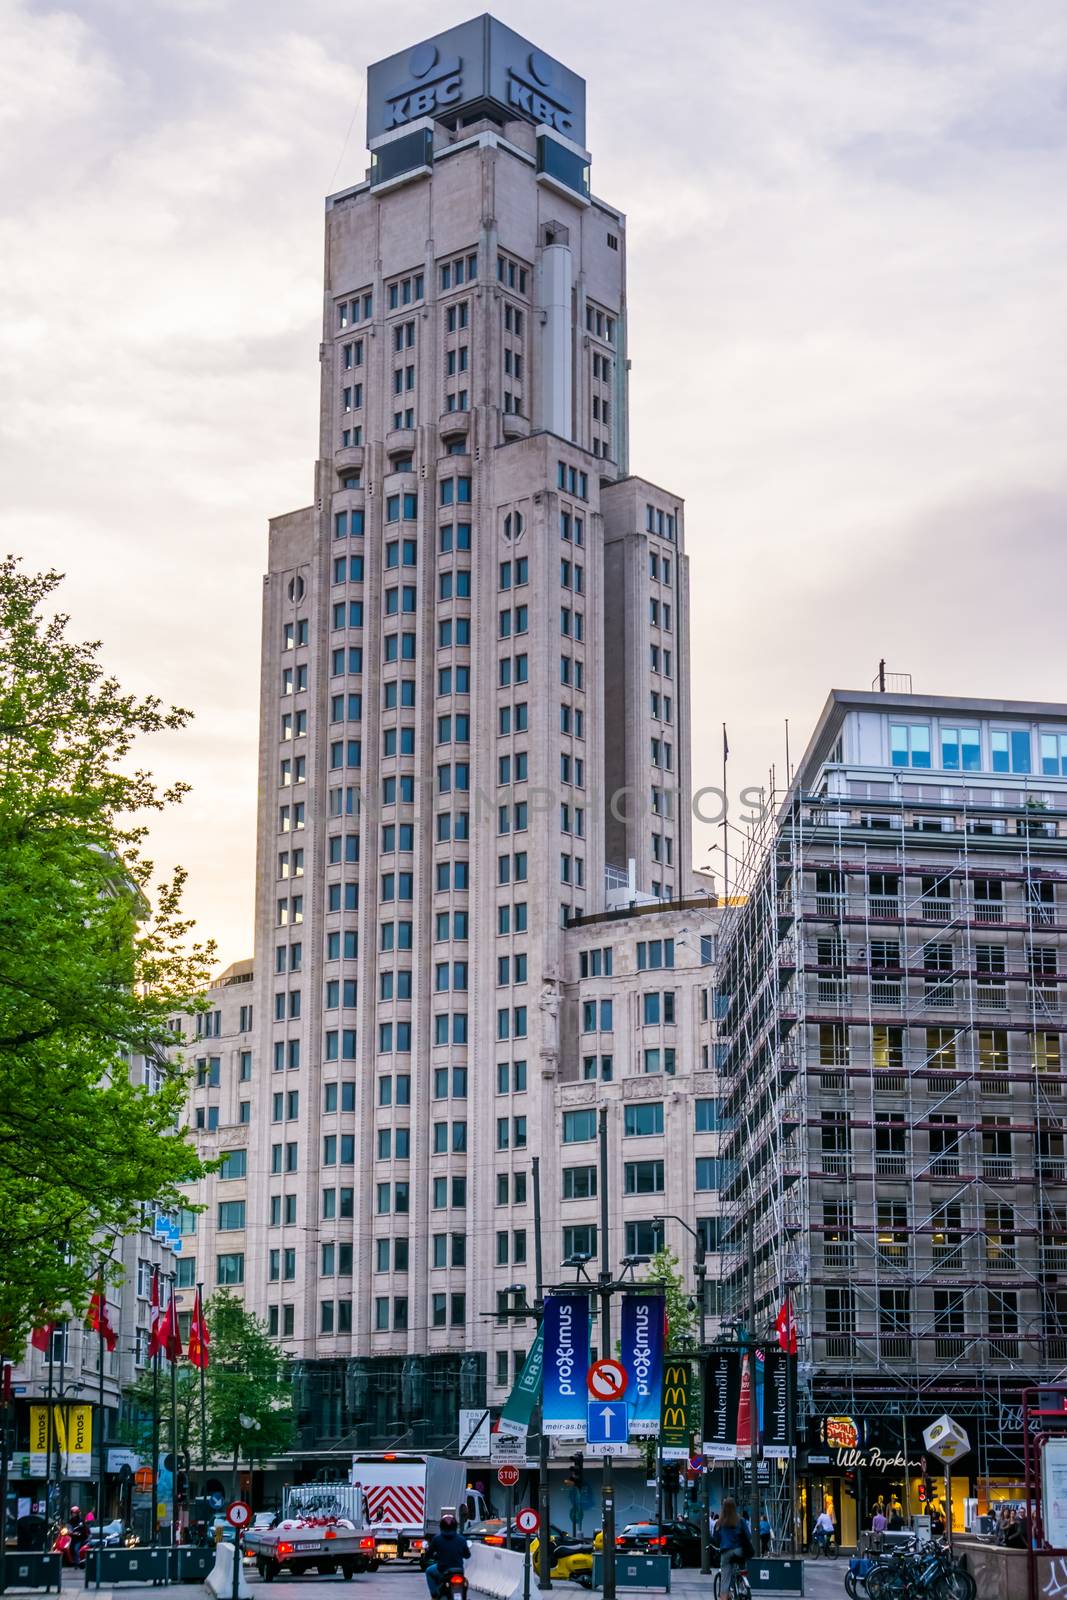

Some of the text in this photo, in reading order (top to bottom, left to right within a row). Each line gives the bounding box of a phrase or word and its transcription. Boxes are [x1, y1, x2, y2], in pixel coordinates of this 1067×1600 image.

[384, 76, 462, 130] KBC
[508, 80, 577, 134] KBC
[556, 1304, 576, 1395] proximus
[633, 1304, 652, 1395] proximus
[714, 1357, 728, 1440] hunkemöller
[773, 1357, 787, 1440] hunkemöller
[998, 1406, 1041, 1430] Ula
[37, 1414, 46, 1450] Panos
[75, 1414, 84, 1450] Panos
[836, 1447, 867, 1467] Ulla
[498, 1471, 519, 1480] STOP
